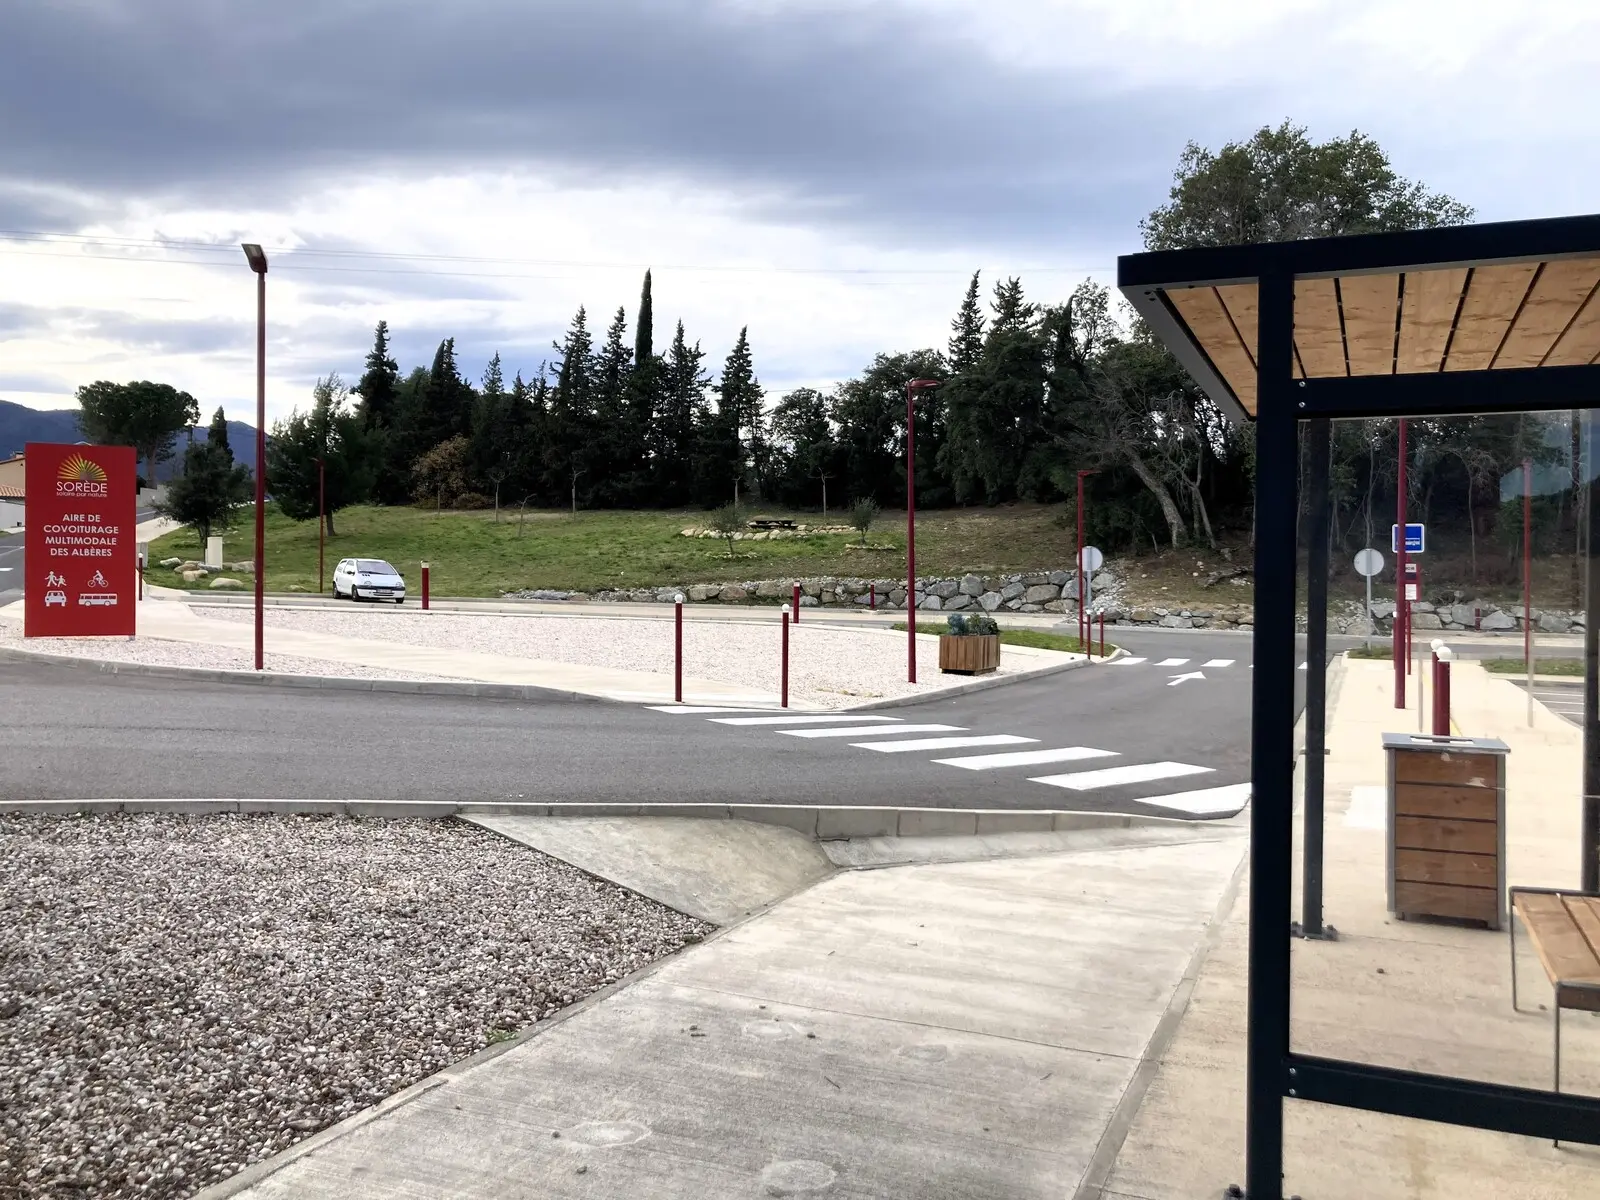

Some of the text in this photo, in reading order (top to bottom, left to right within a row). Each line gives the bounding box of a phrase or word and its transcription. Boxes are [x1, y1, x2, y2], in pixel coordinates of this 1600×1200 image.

[56, 480, 108, 493] SORÈDE
[62, 514, 101, 522] AIRE DE
[43, 525, 119, 534] COVOITURAGE
[45, 536, 117, 545] MULTIMODALE
[50, 546, 112, 557] DES ALBÈRES
